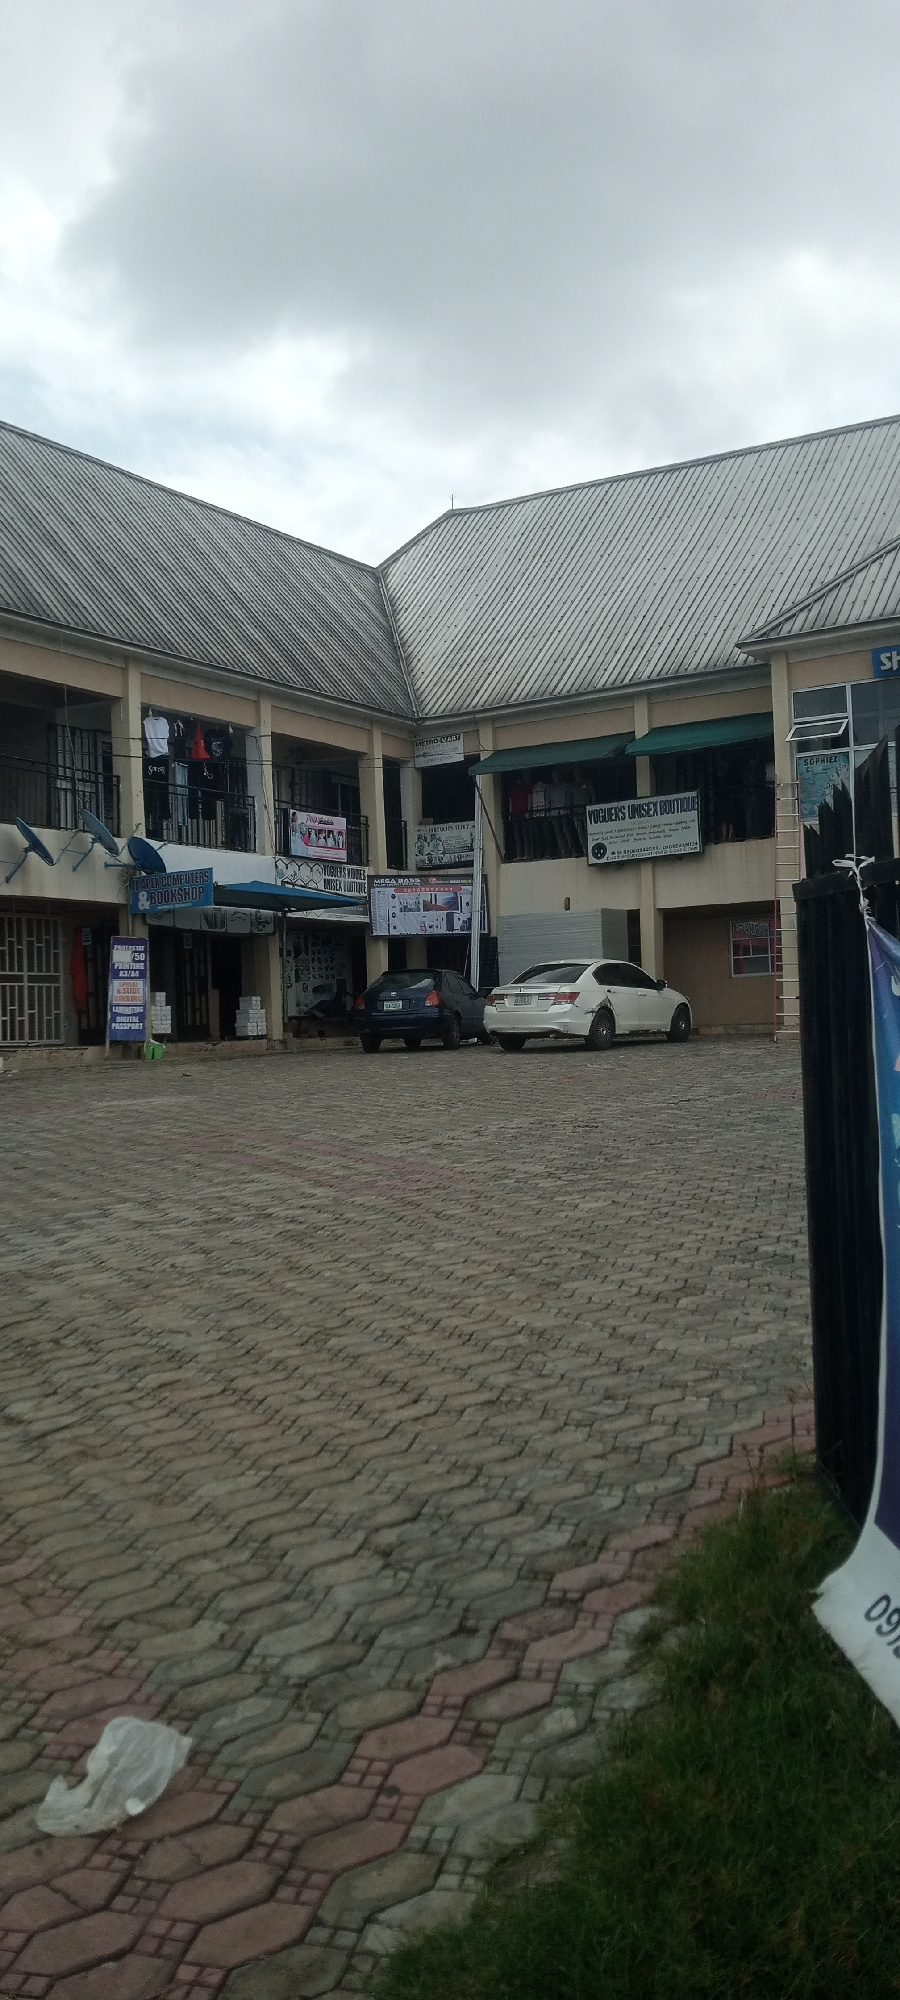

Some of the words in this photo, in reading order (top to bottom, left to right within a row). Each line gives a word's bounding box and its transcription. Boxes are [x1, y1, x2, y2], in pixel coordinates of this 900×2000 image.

[803, 755, 838, 767] SOPHIEZ
[627, 801, 659, 820] UNISEX
[659, 796, 697, 816] BOUTIQUE
[141, 876, 160, 890] APEX
[161, 870, 210, 889] COMPUTERS
[323, 878, 343, 892] UNISEX
[138, 891, 150, 911] &
[150, 885, 205, 906] BOOKSHOP
[114, 962, 145, 970] PRINTING
[122, 987, 141, 995] SLIDE
[113, 995, 143, 1003] BINDING
